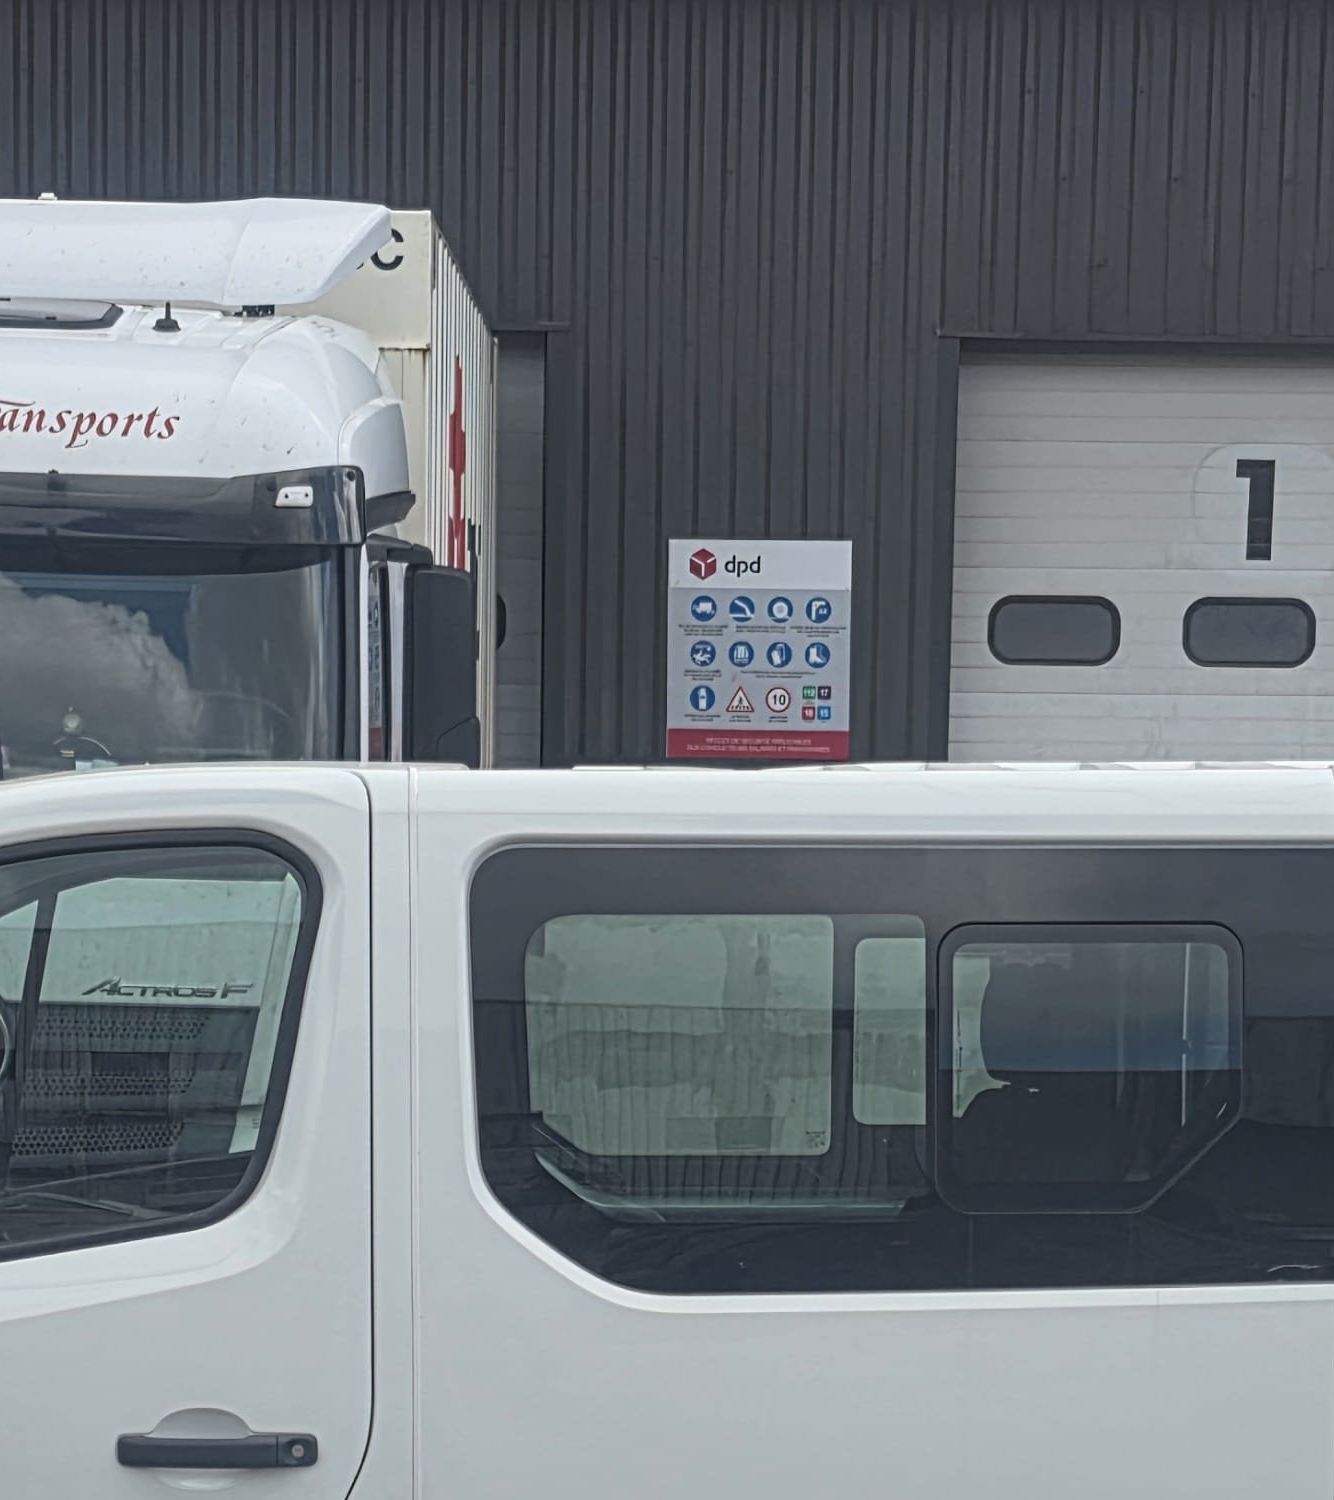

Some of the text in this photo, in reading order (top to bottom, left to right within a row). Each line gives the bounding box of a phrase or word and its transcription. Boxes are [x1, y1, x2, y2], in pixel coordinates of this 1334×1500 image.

[1235, 459, 1276, 561] 1
[724, 555, 761, 578] dpd
[773, 694, 787, 706] 10
[220, 981, 254, 999] F
